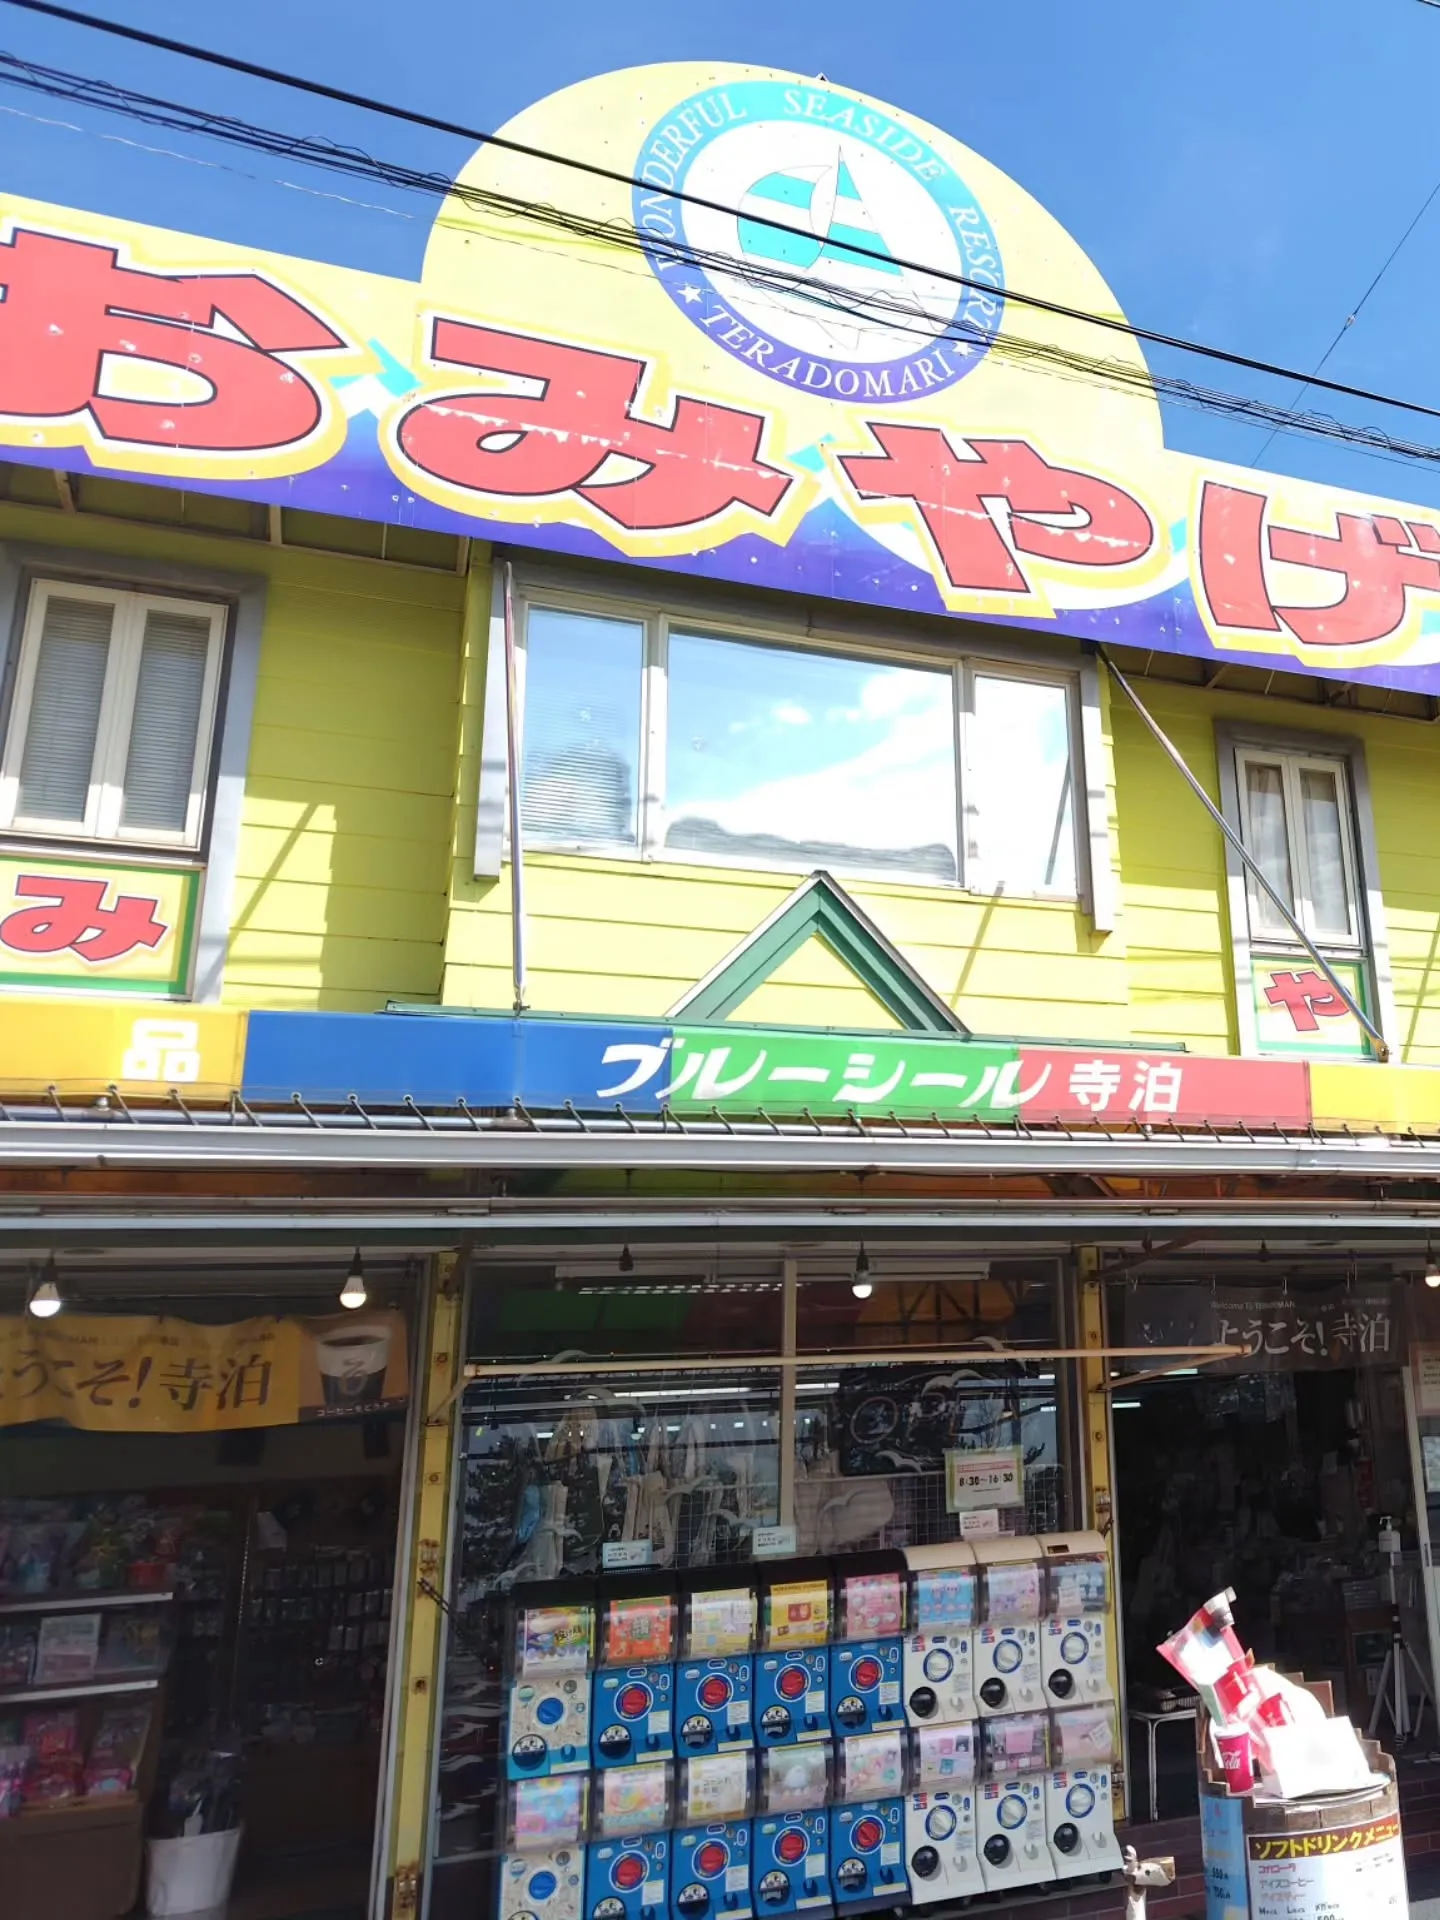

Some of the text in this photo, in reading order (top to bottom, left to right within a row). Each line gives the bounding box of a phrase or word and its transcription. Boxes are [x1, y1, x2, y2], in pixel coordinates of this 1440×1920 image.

[783, 88, 945, 182] SEASIDE
[949, 204, 1001, 341] RESORT
[698, 304, 956, 399] TERADOMARI
[121, 1019, 201, 1082] 品
[596, 1038, 1184, 1113] ブルーシール 寺泊
[1255, 1822, 1399, 1860] ソフトドリンクメニュー
